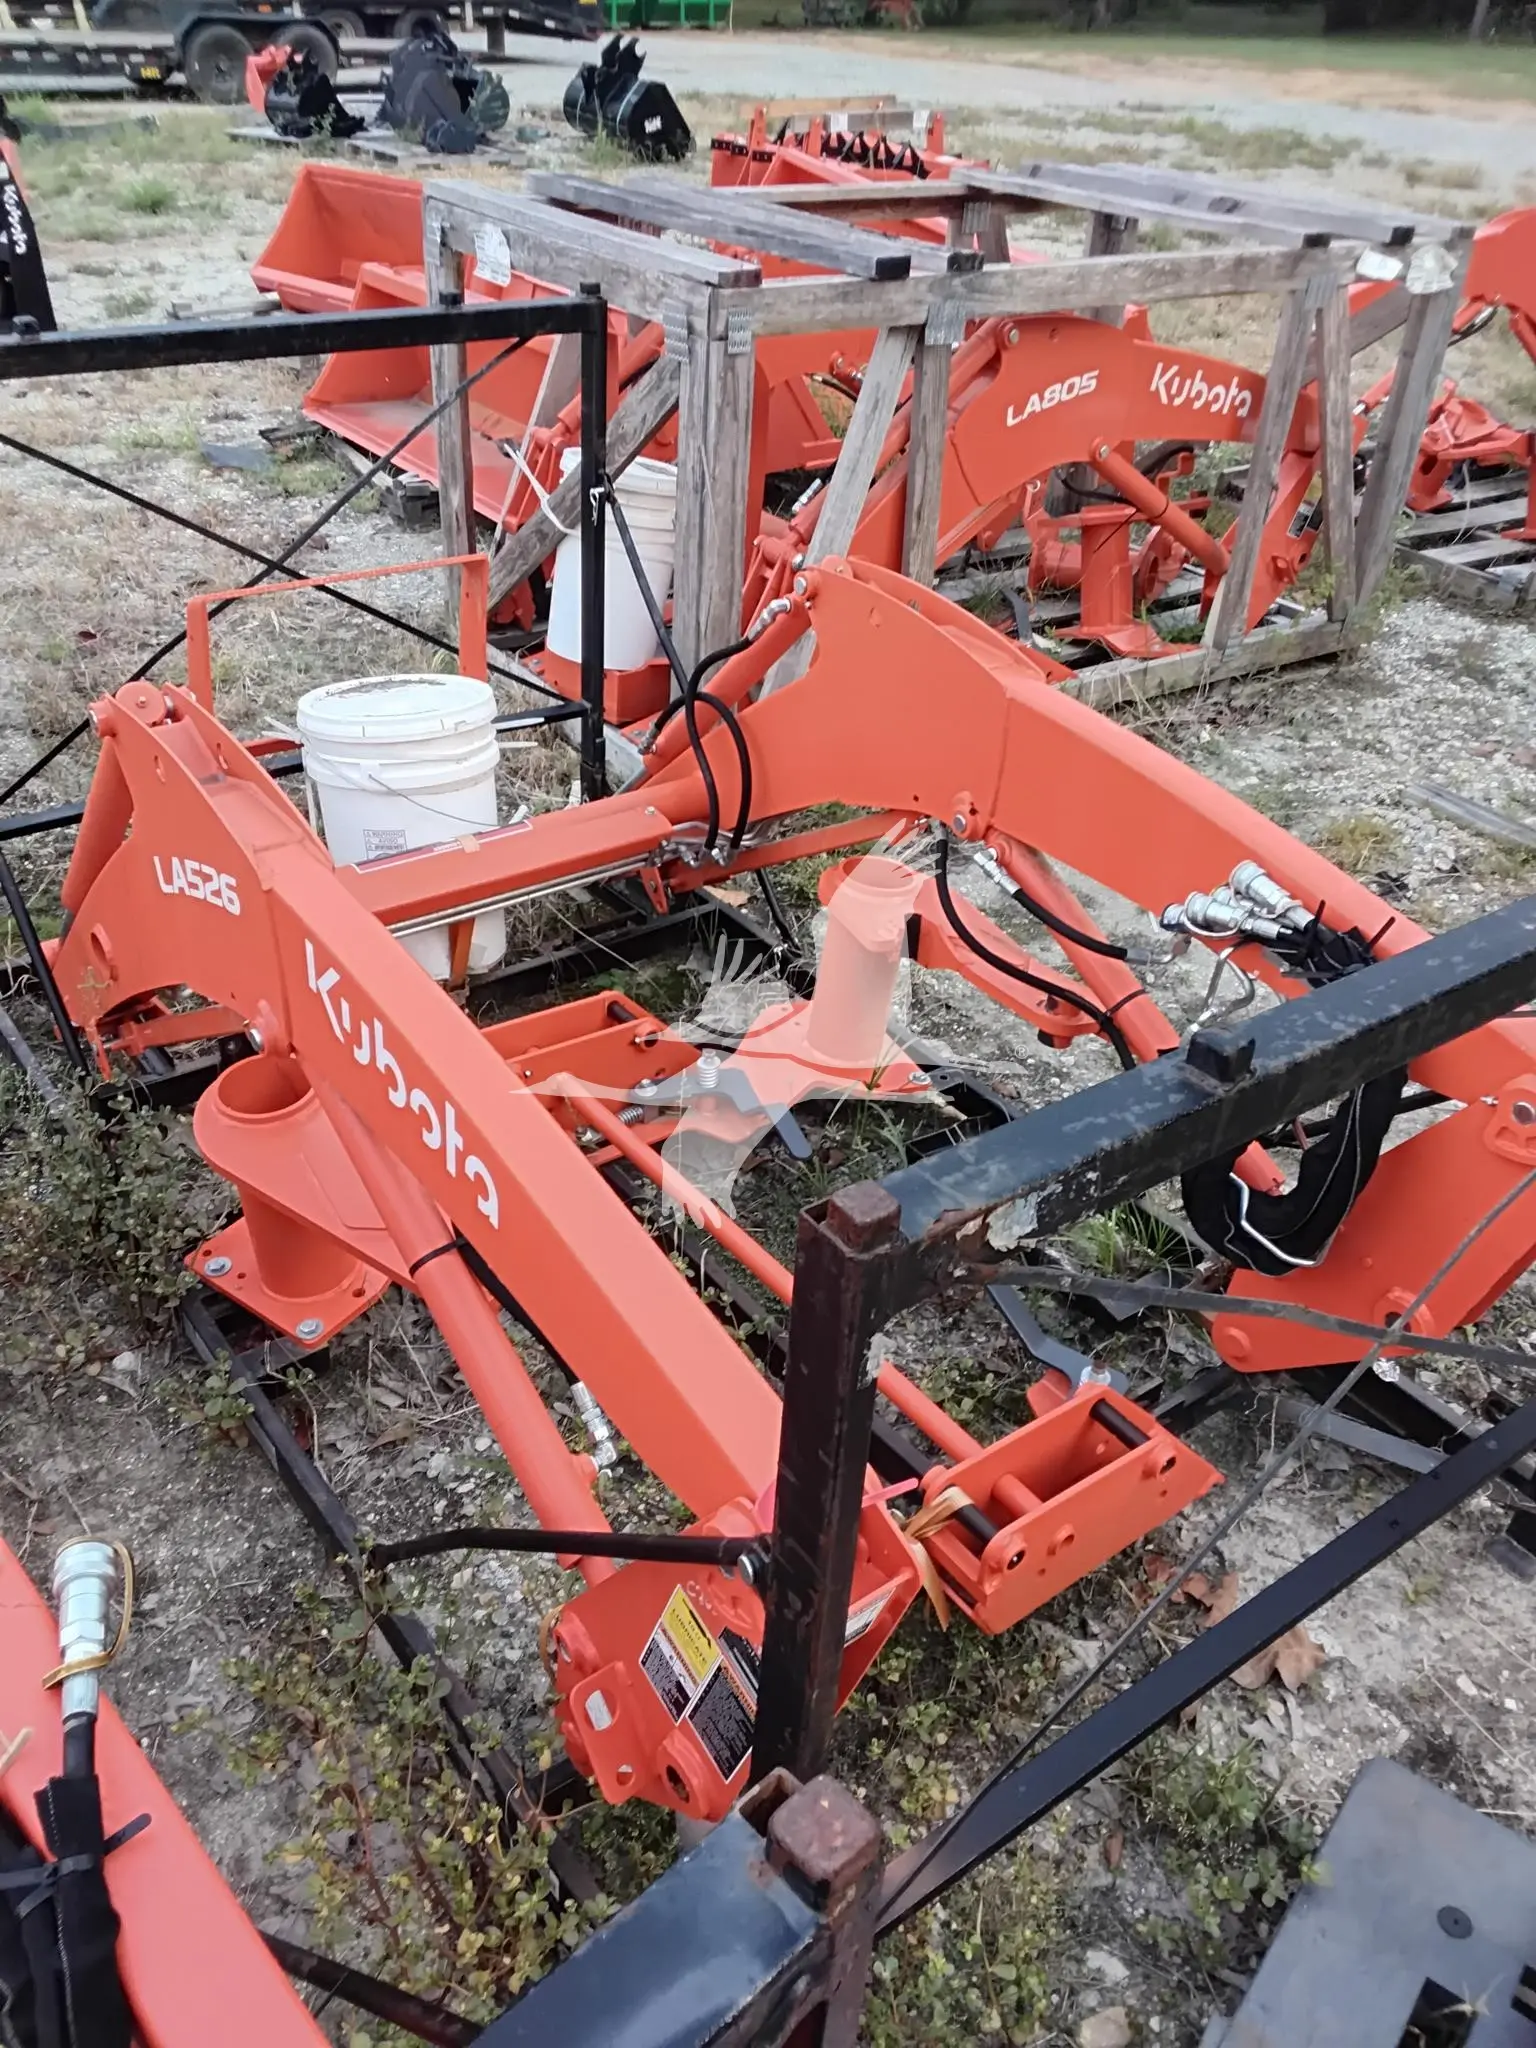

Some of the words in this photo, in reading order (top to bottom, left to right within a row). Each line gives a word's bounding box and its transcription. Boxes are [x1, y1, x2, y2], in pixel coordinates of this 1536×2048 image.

[1006, 369, 1100, 428] LA805
[1150, 362, 1252, 418] Kubota
[153, 856, 241, 916] LA526
[305, 939, 499, 1230] Kubota
